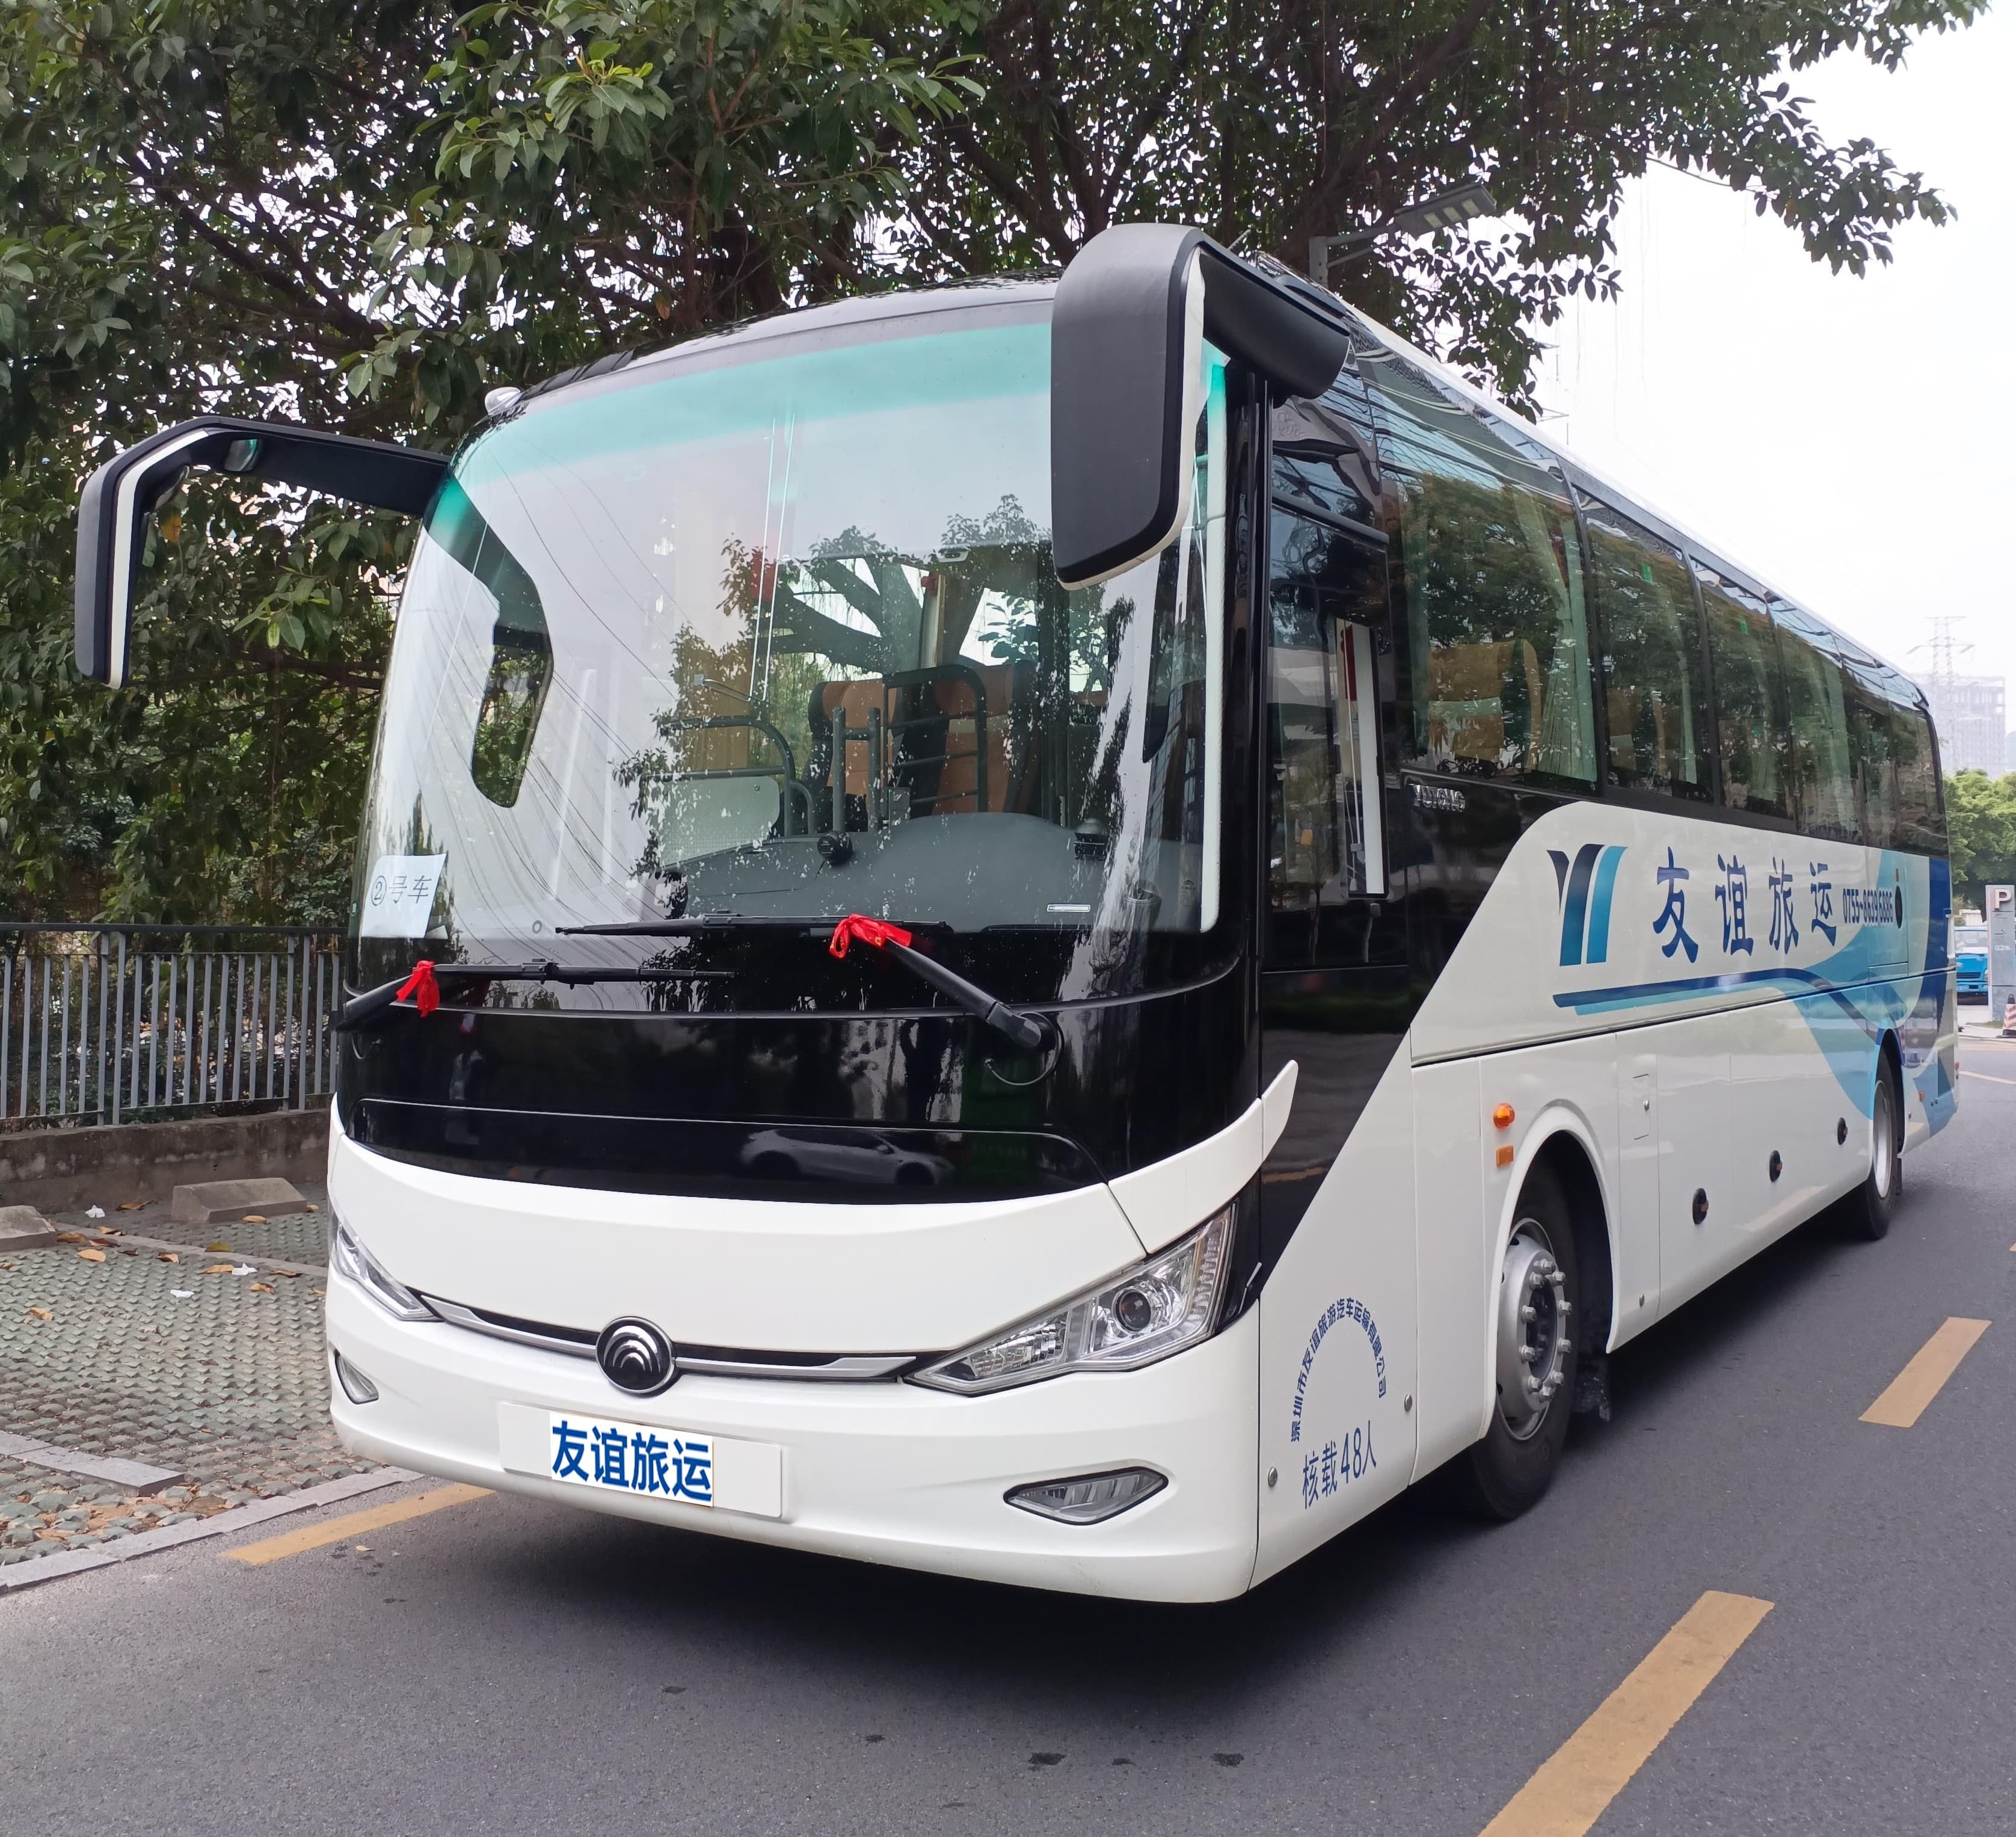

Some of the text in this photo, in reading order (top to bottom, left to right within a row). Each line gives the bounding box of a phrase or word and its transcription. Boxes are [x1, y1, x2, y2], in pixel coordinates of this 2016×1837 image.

[1653, 846, 1837, 964] 友谊旅运
[1992, 888, 2012, 910] P
[1291, 1297, 1386, 1442] 深圳市友谊旅游汽车运输有限公司
[1302, 1420, 1377, 1510] 核载48人
